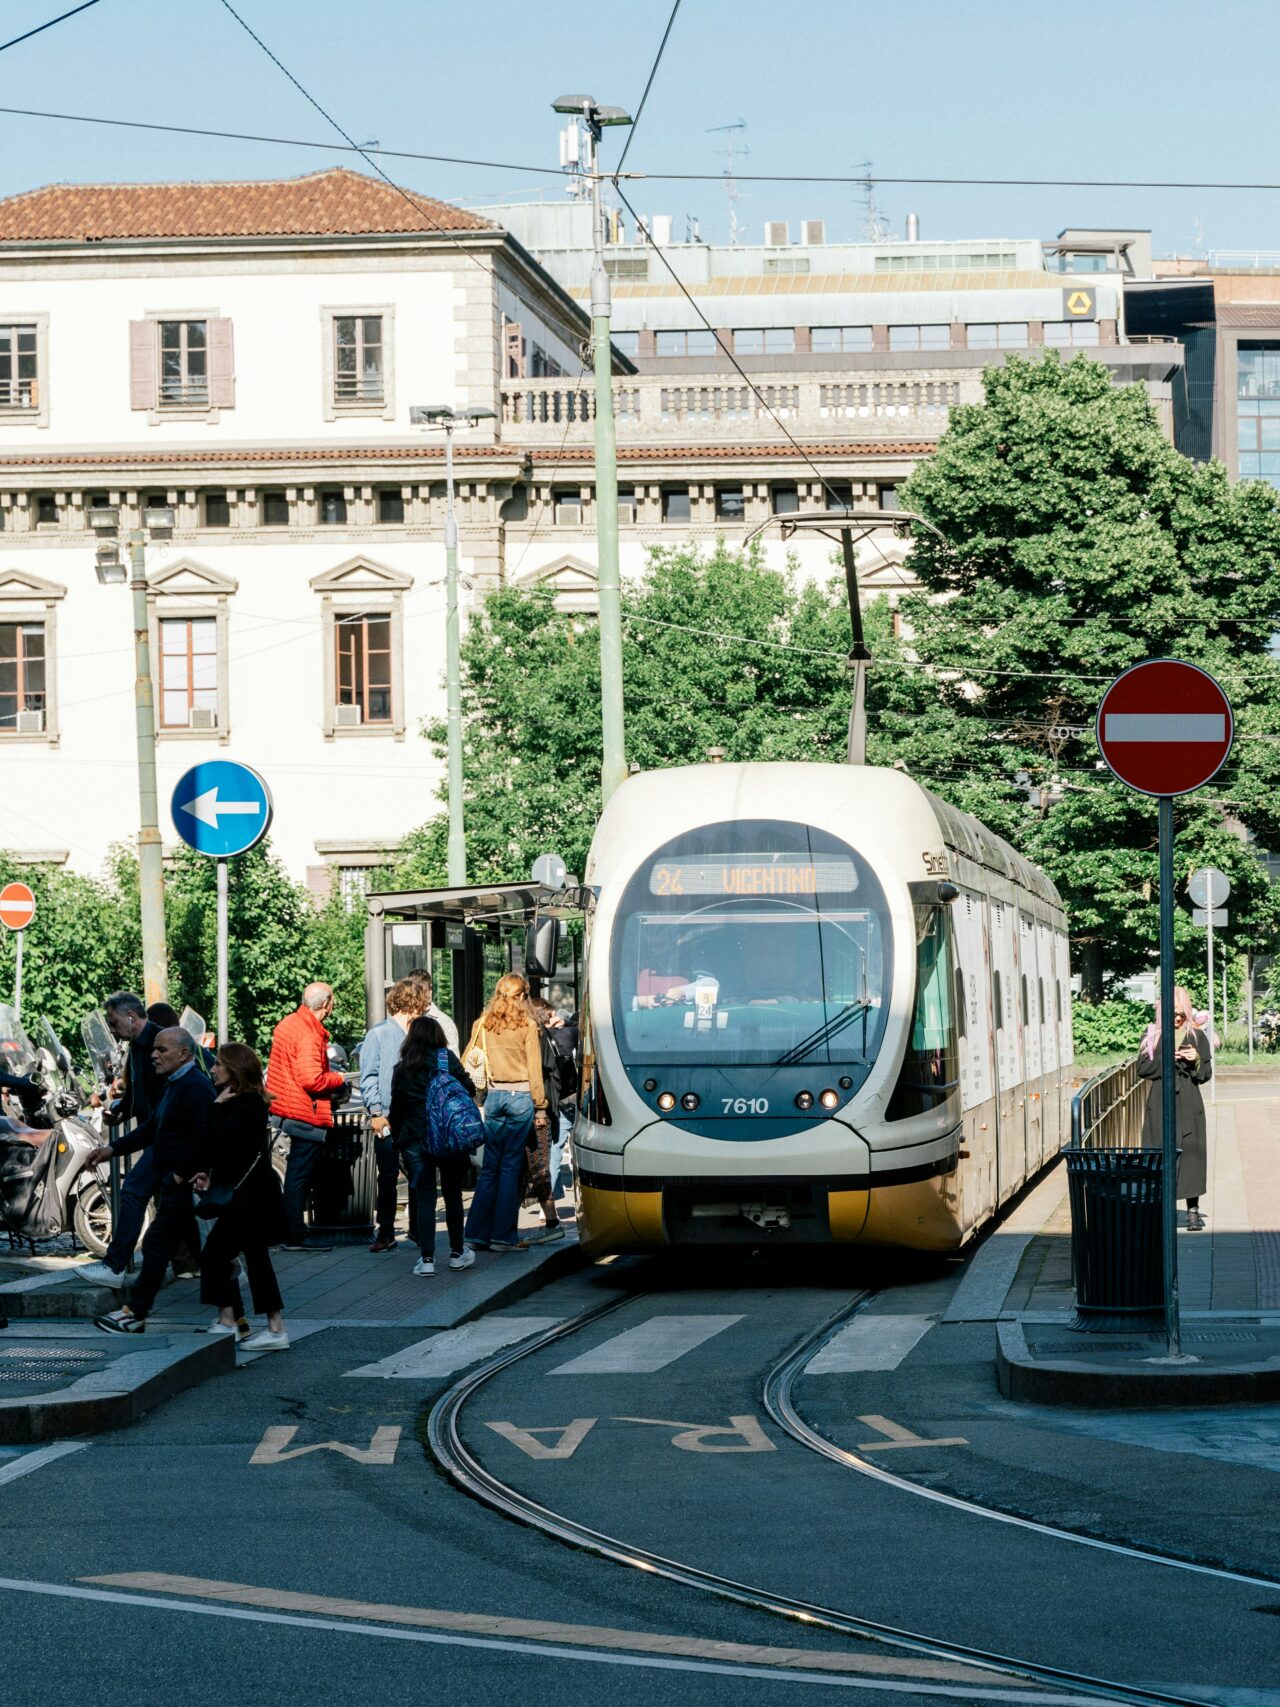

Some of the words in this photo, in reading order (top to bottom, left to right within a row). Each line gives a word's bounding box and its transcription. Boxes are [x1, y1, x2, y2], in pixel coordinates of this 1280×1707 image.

[657, 867, 684, 895] 24
[700, 1005, 712, 1016] 24
[721, 1097, 769, 1114] 7610
